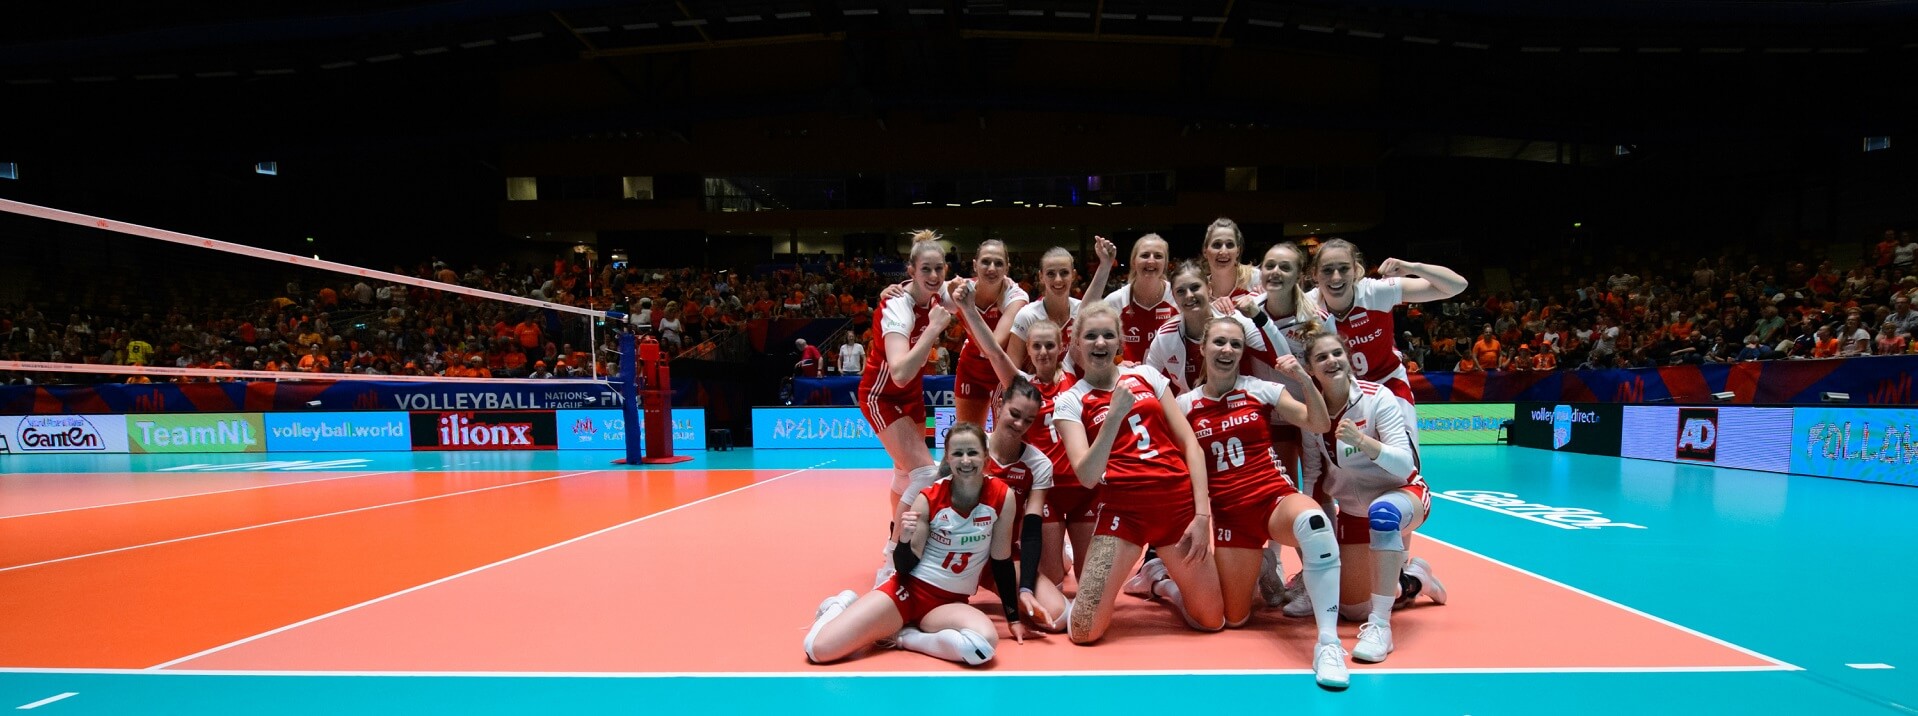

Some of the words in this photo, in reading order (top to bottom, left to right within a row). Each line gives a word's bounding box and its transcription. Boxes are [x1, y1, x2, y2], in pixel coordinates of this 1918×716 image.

[1348, 335, 1375, 348] plus
[960, 383, 971, 395] 10
[394, 392, 541, 410] VOLLEYBALL
[544, 391, 589, 401] NATIONS
[135, 418, 257, 447] TeamNL
[271, 420, 404, 442] volleyball.world
[440, 413, 532, 446] ilionx
[1127, 413, 1151, 451] 5
[1221, 414, 1250, 432] plus
[1678, 417, 1717, 450] AD
[1210, 437, 1245, 472] 20
[1110, 515, 1121, 531] 5
[1217, 527, 1232, 542] 20
[895, 585, 910, 601] 13
